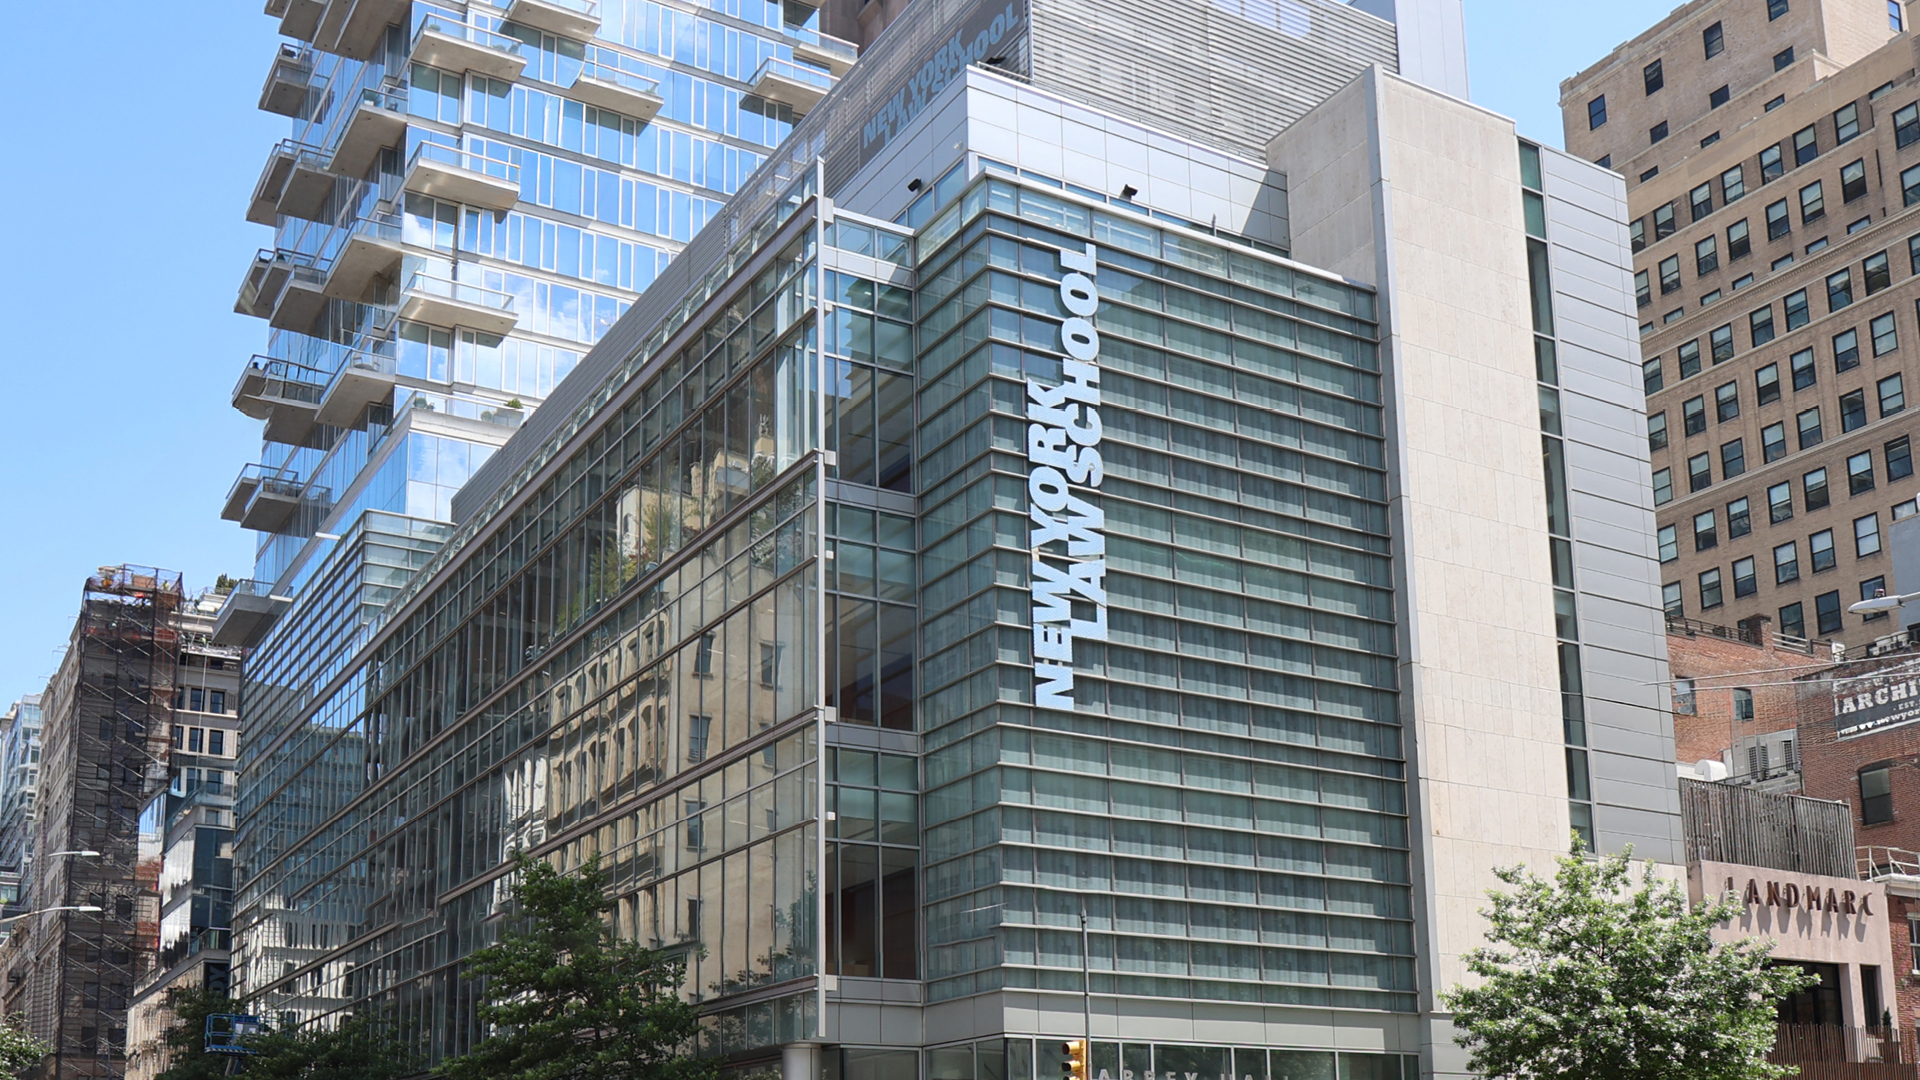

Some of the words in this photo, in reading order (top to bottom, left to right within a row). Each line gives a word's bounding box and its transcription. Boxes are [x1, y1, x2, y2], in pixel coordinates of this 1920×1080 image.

[863, 85, 906, 148] NEW
[908, 28, 967, 96] YORK
[1060, 243, 1104, 487] SCHOOL
[1027, 378, 1069, 548] YORK
[1032, 559, 1074, 711] NEW
[1067, 499, 1108, 641] LAW
